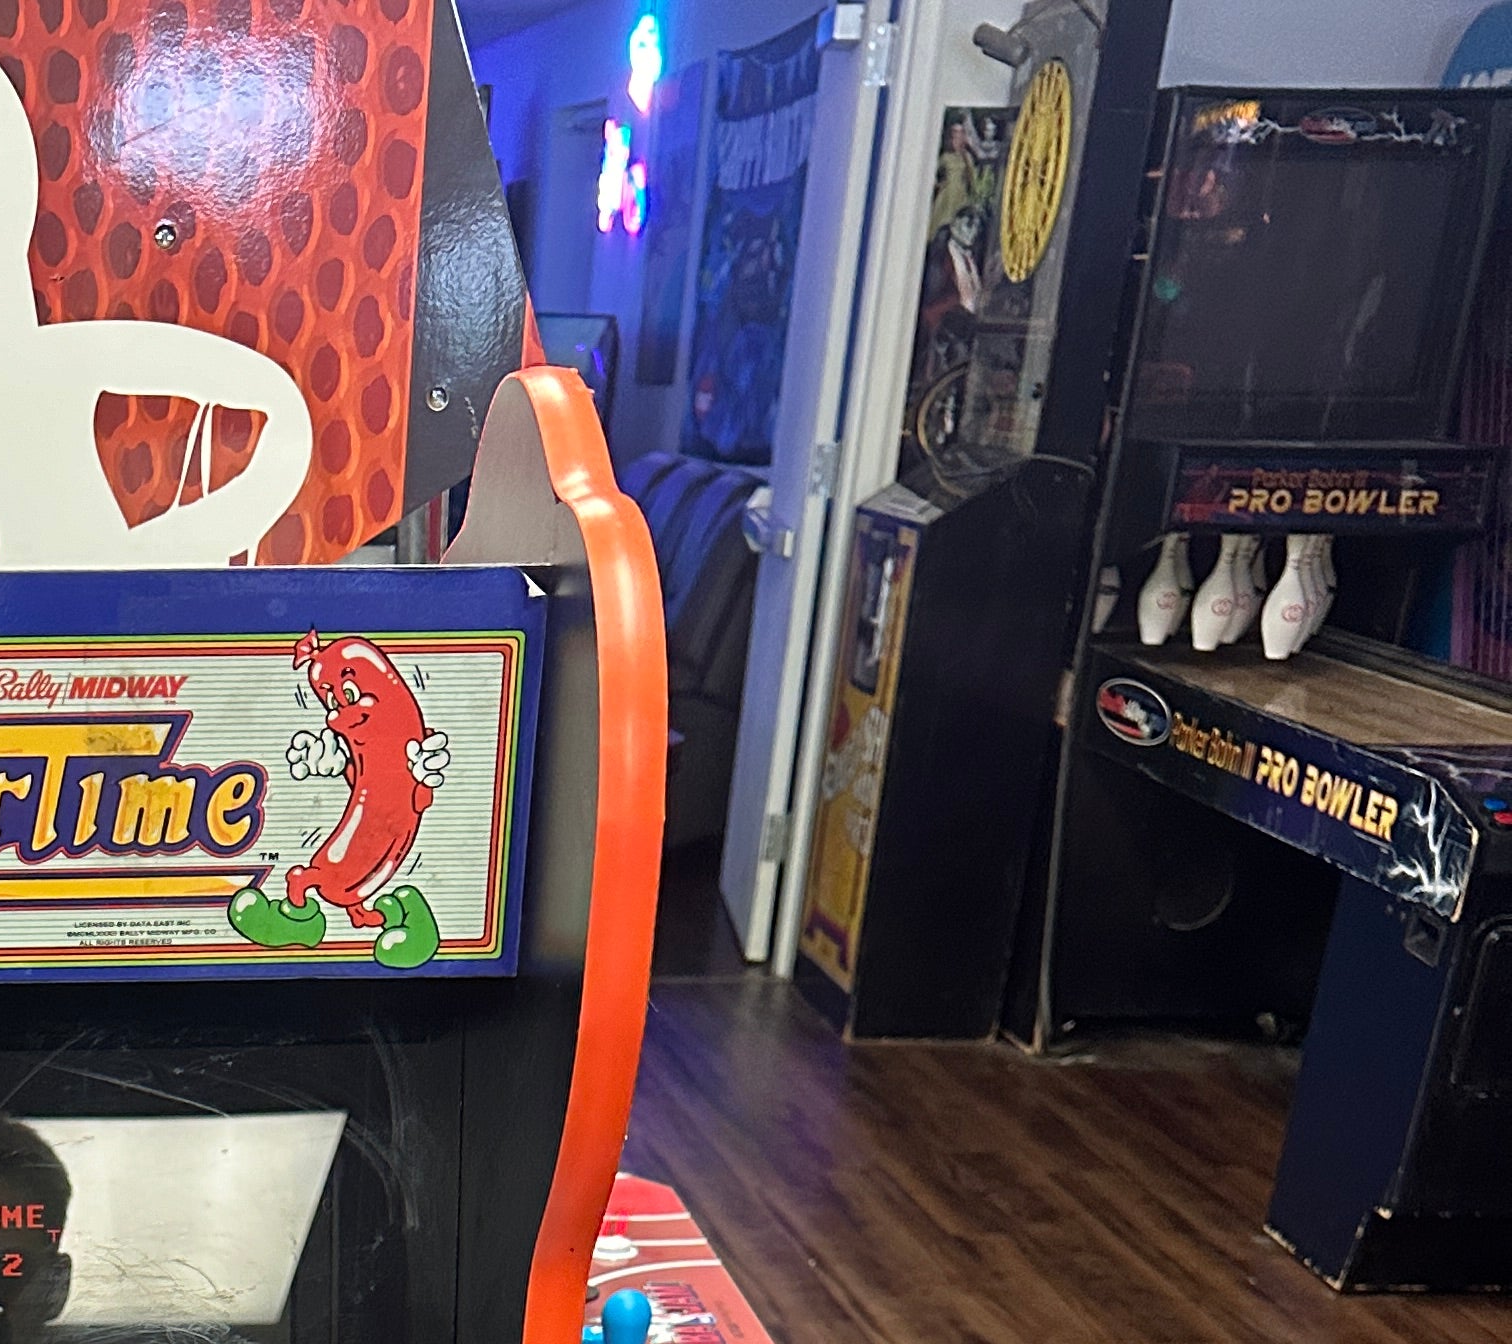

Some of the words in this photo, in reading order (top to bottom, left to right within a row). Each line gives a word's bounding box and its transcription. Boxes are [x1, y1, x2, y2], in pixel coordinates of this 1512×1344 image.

[1228, 488, 1292, 514] PRO
[1303, 489, 1439, 515] BOWLER
[68, 674, 189, 699] MIDWAY
[1255, 745, 1300, 798] PRO
[1300, 763, 1399, 842] BOWLER
